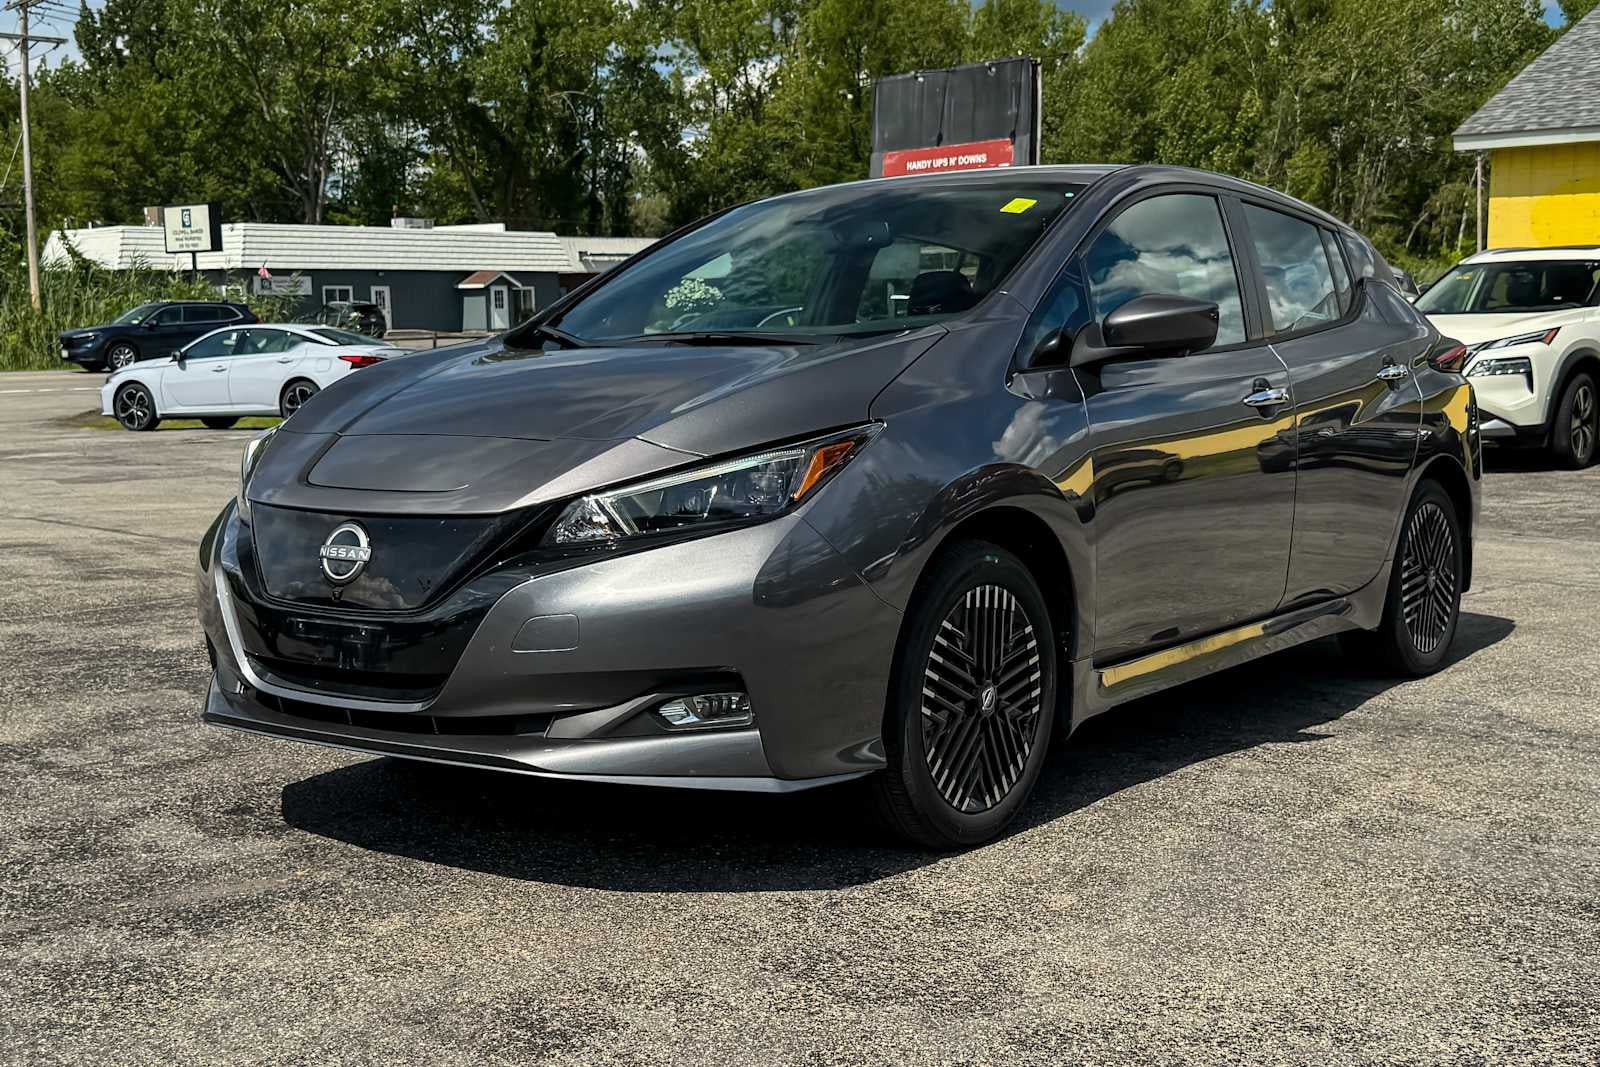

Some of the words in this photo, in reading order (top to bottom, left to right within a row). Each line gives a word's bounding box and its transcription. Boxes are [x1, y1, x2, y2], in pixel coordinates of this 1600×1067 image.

[906, 160, 932, 171] HANDY
[932, 157, 949, 168] UPS
[958, 153, 987, 165] DOWNS
[320, 547, 370, 560] NISSAN
